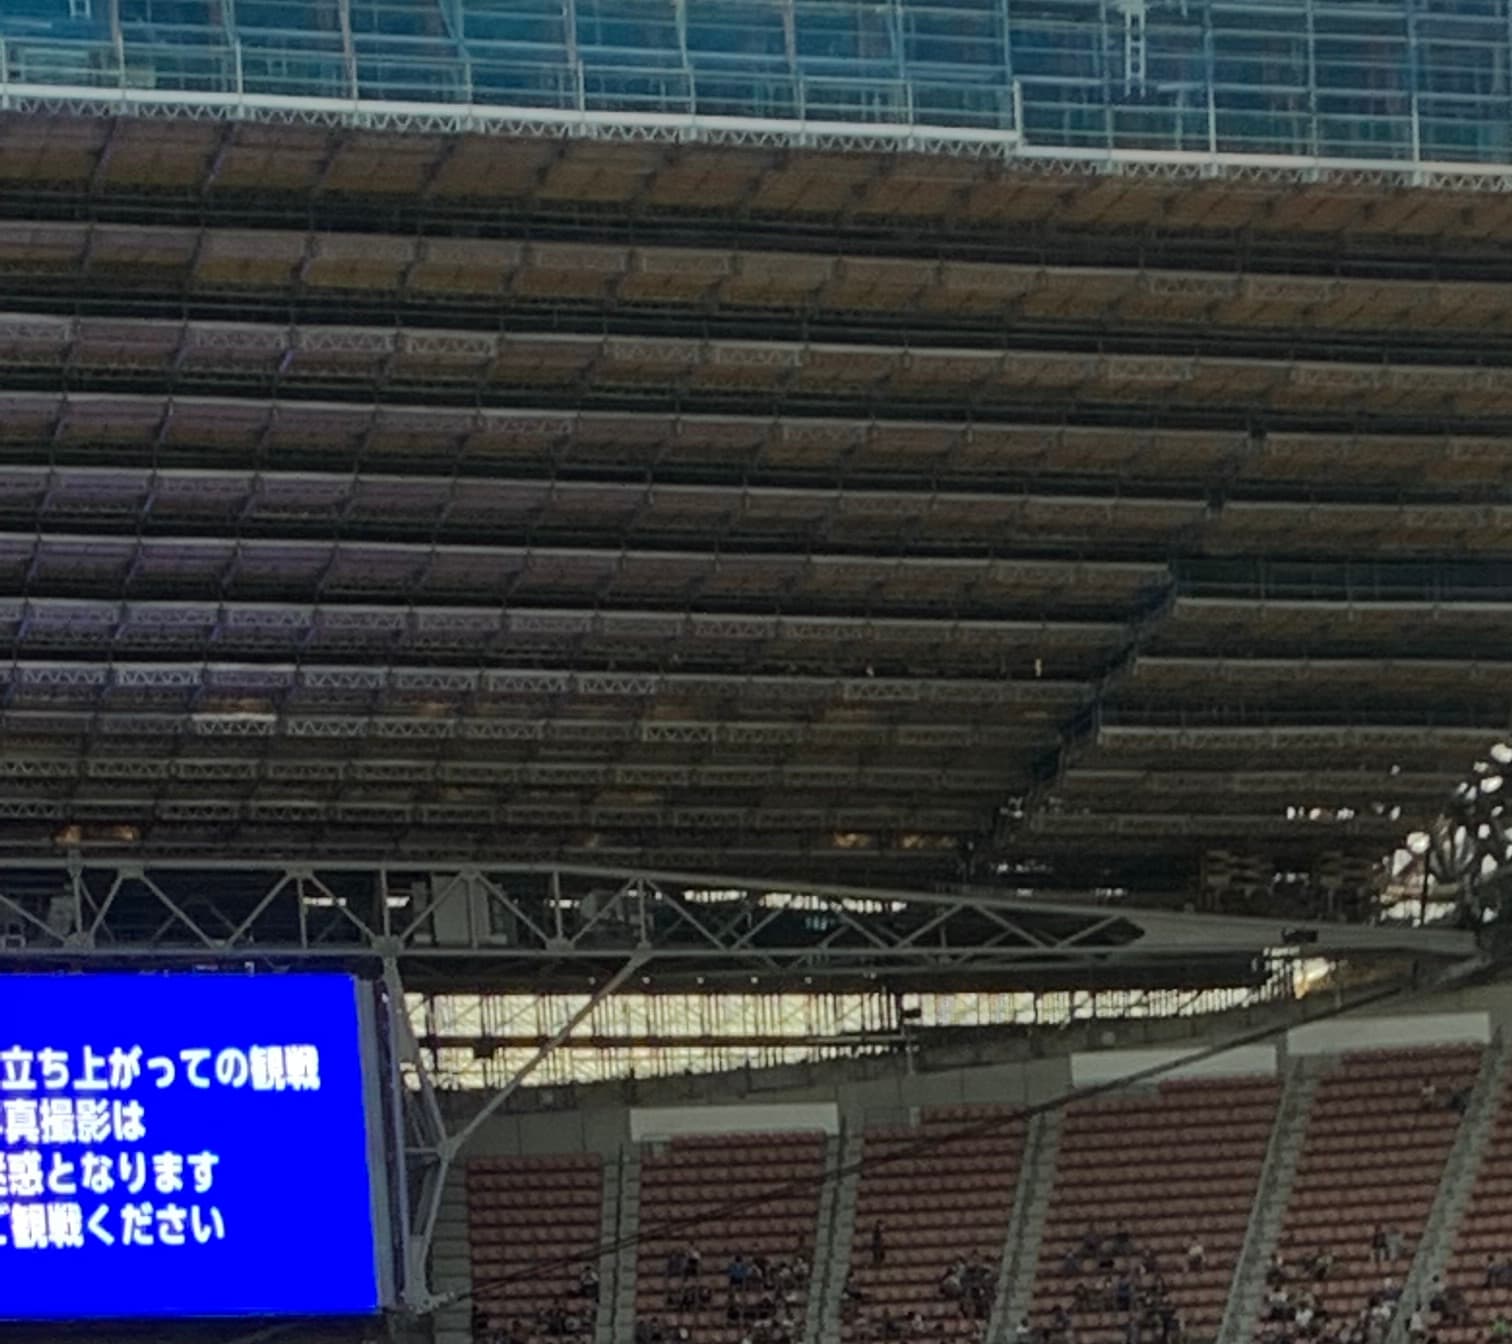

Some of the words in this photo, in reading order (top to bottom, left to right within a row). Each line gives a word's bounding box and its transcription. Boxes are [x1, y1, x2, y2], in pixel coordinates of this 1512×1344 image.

[1, 1045, 320, 1090] 立ち上がっての観戦
[0, 1099, 145, 1144] 真撮影は
[0, 1150, 218, 1196] 惑となります
